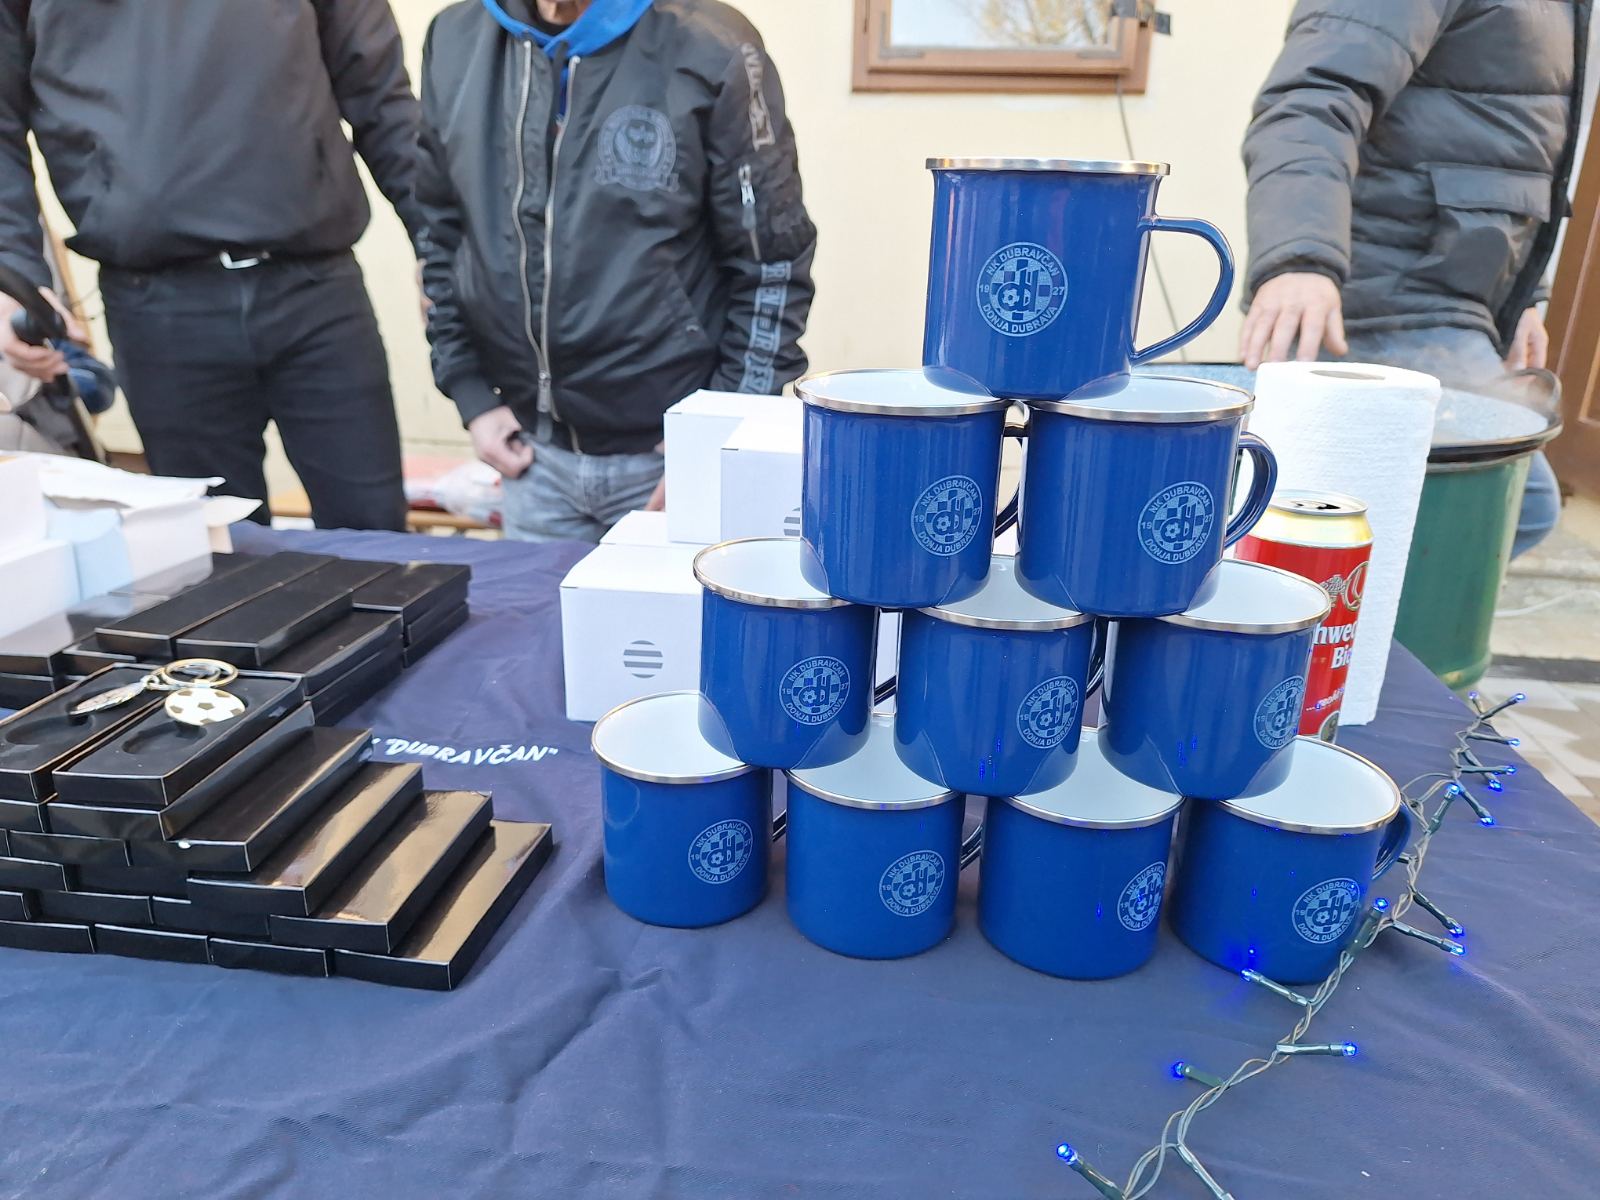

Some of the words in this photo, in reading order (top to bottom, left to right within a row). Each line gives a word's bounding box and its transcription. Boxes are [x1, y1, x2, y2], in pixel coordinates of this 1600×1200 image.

[986, 259, 1001, 277] NK
[999, 247, 1060, 277] DUBRAVČAN
[979, 284, 990, 293] 19
[1051, 286, 1065, 296] 27
[982, 303, 1009, 332] DONJA
[1011, 306, 1058, 333] DUBRAVA
[921, 493, 935, 507] NK
[1148, 499, 1164, 514] NK
[914, 514, 925, 523] 19
[919, 531, 943, 553] DONJA
[944, 524, 977, 553] DUBRAVA
[1145, 538, 1171, 560] DONJA
[1172, 532, 1207, 560] DUBRAVA
[787, 668, 800, 682] NK
[1025, 693, 1039, 707] NK
[785, 702, 810, 722] DONJA
[811, 697, 845, 722] DUBRAVA
[1023, 728, 1045, 746] DONJA
[695, 836, 708, 848] NK
[695, 866, 719, 882] DONJA
[887, 866, 900, 879] NK
[886, 897, 909, 914] DONJA
[1297, 922, 1320, 941] DONJA
